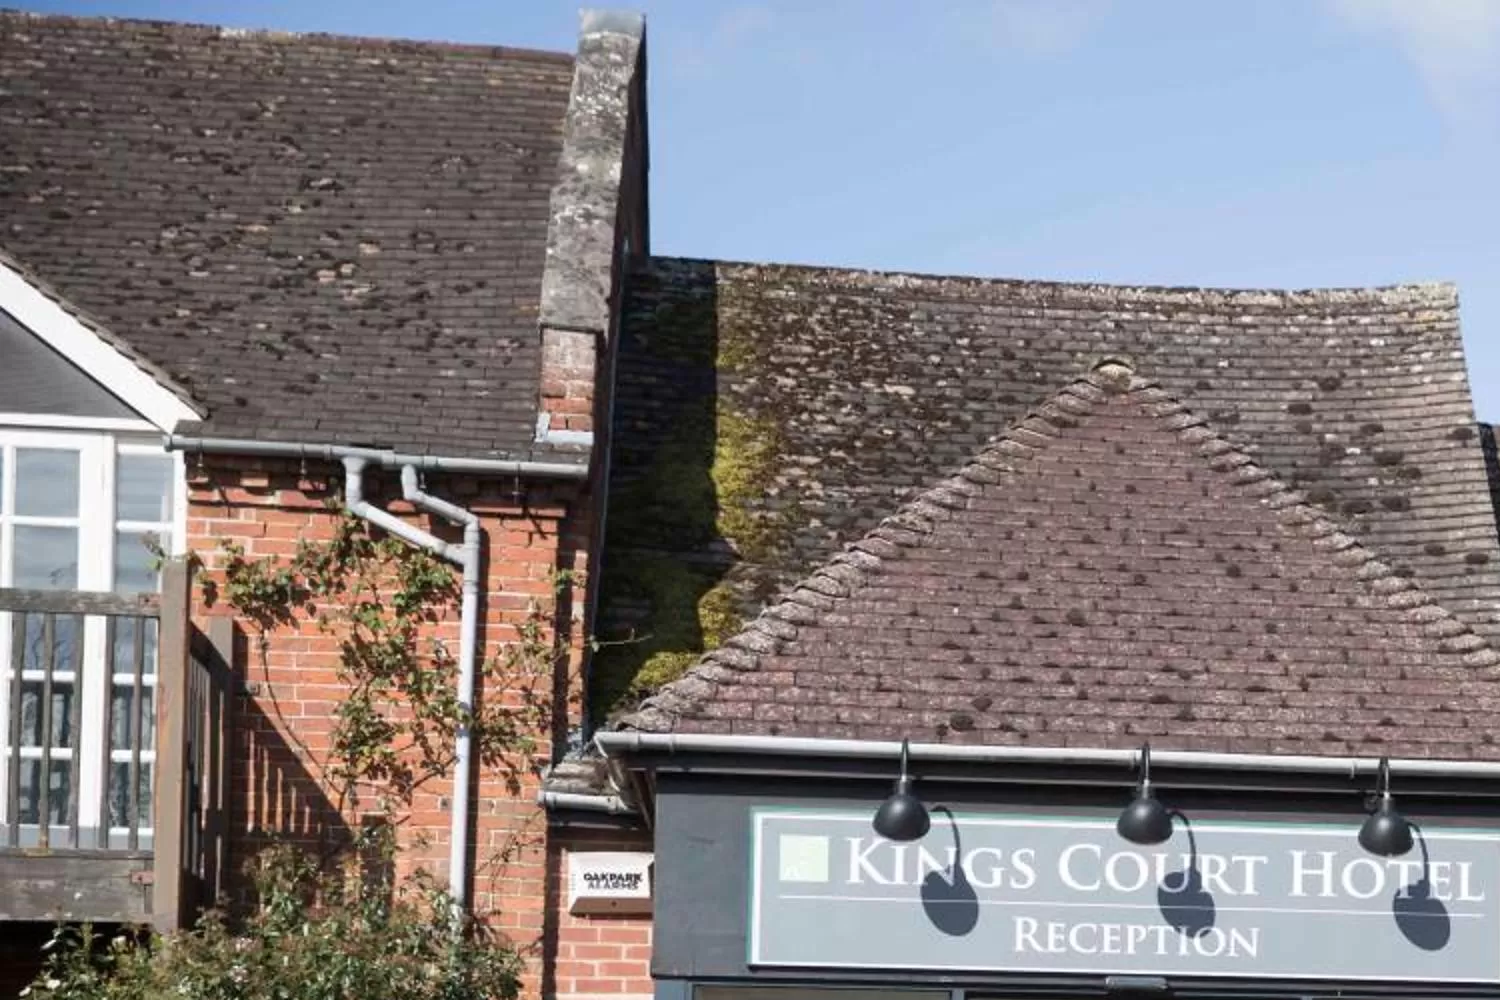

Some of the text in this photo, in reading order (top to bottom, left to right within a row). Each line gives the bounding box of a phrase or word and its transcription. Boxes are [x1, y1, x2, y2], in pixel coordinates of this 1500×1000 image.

[583, 872, 643, 882] OAKPARK
[844, 837, 1486, 902] KINGS COURT HOTEL
[1011, 916, 1261, 958] RECEPTION
